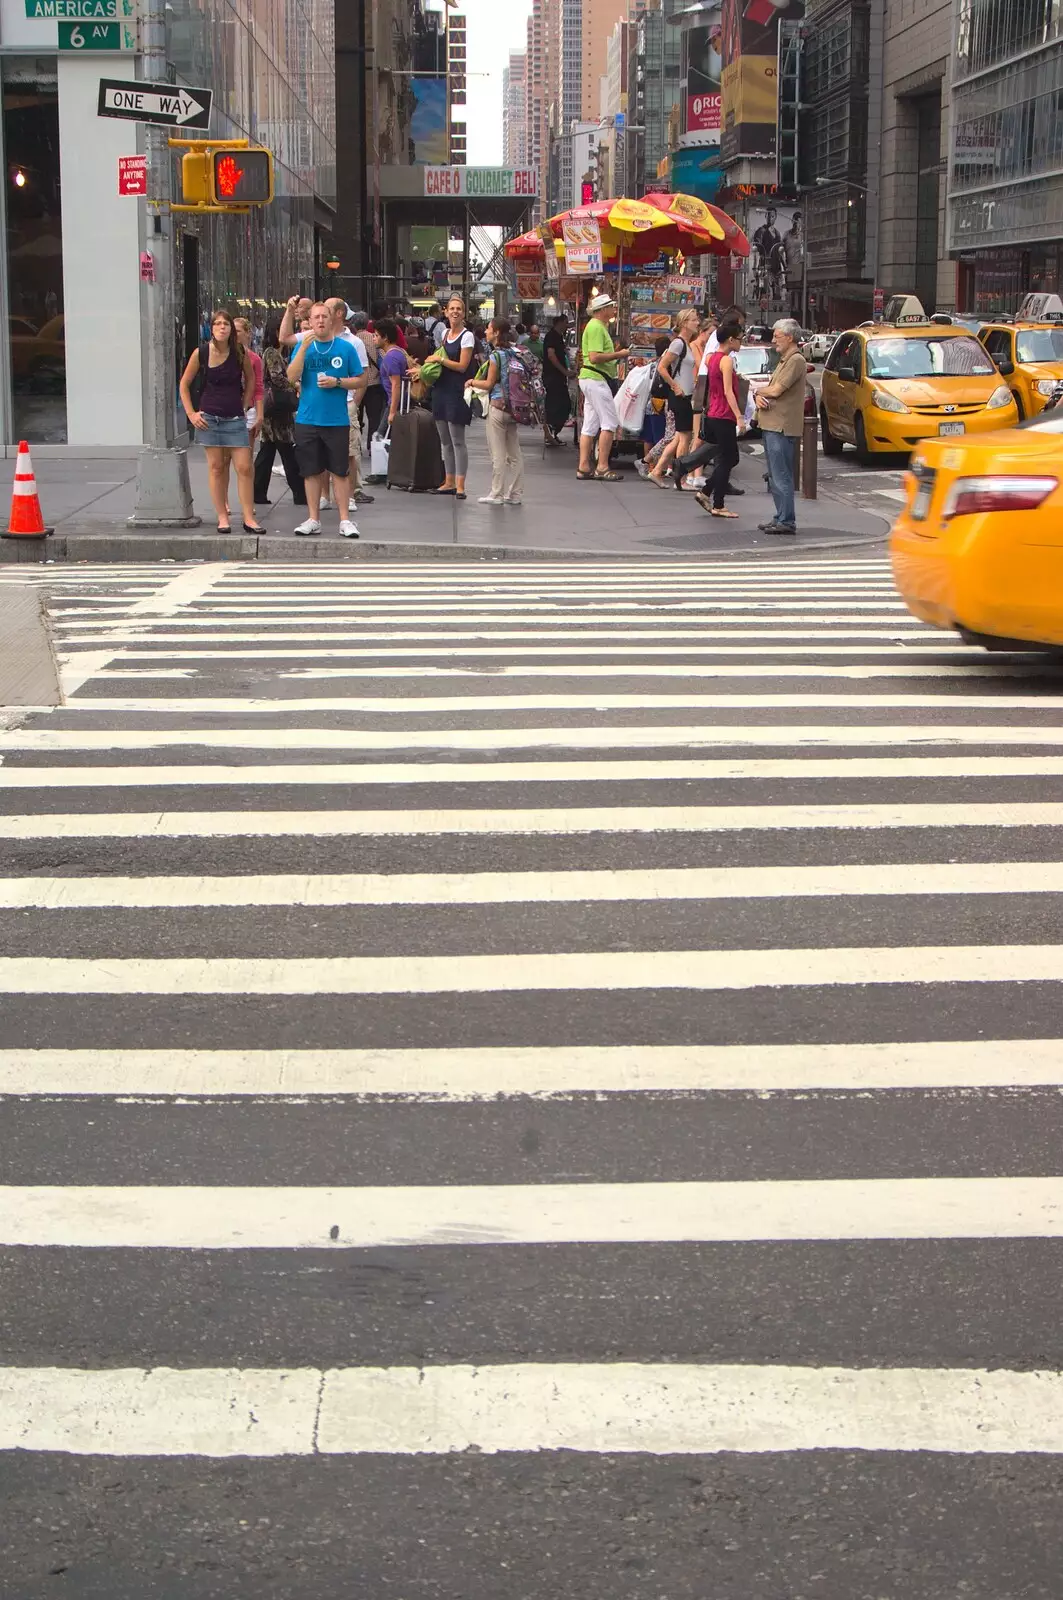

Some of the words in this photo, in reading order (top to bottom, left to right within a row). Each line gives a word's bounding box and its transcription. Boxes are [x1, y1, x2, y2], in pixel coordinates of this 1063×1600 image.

[34, 1, 116, 17] AMERICAS
[70, 26, 85, 48] 6
[92, 25, 109, 37] AV
[113, 92, 144, 109] ONE
[159, 97, 193, 115] WAY
[123, 170, 144, 180] ANYTIME
[426, 170, 451, 194] CAFE
[465, 170, 513, 194] GOURMET
[514, 170, 536, 194] DELI
[687, 279, 703, 287] DOG
